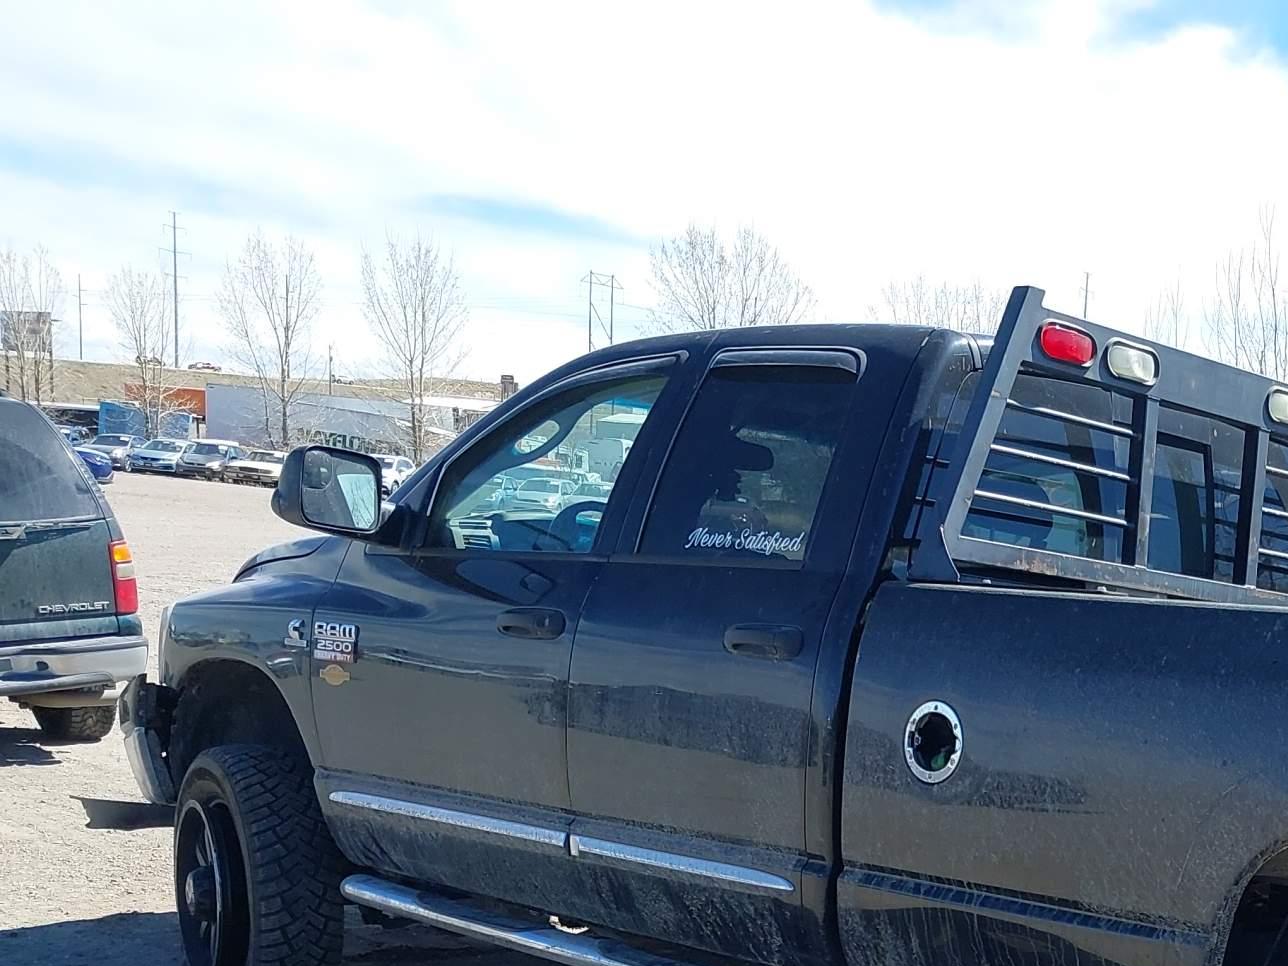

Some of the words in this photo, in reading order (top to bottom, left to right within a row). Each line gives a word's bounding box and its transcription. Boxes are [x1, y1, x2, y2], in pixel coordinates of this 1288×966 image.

[684, 527, 733, 549] Never
[734, 527, 805, 556] Satisfied
[38, 601, 110, 614] CHEVROLET
[315, 621, 356, 639] RAM
[317, 640, 352, 653] 2500
